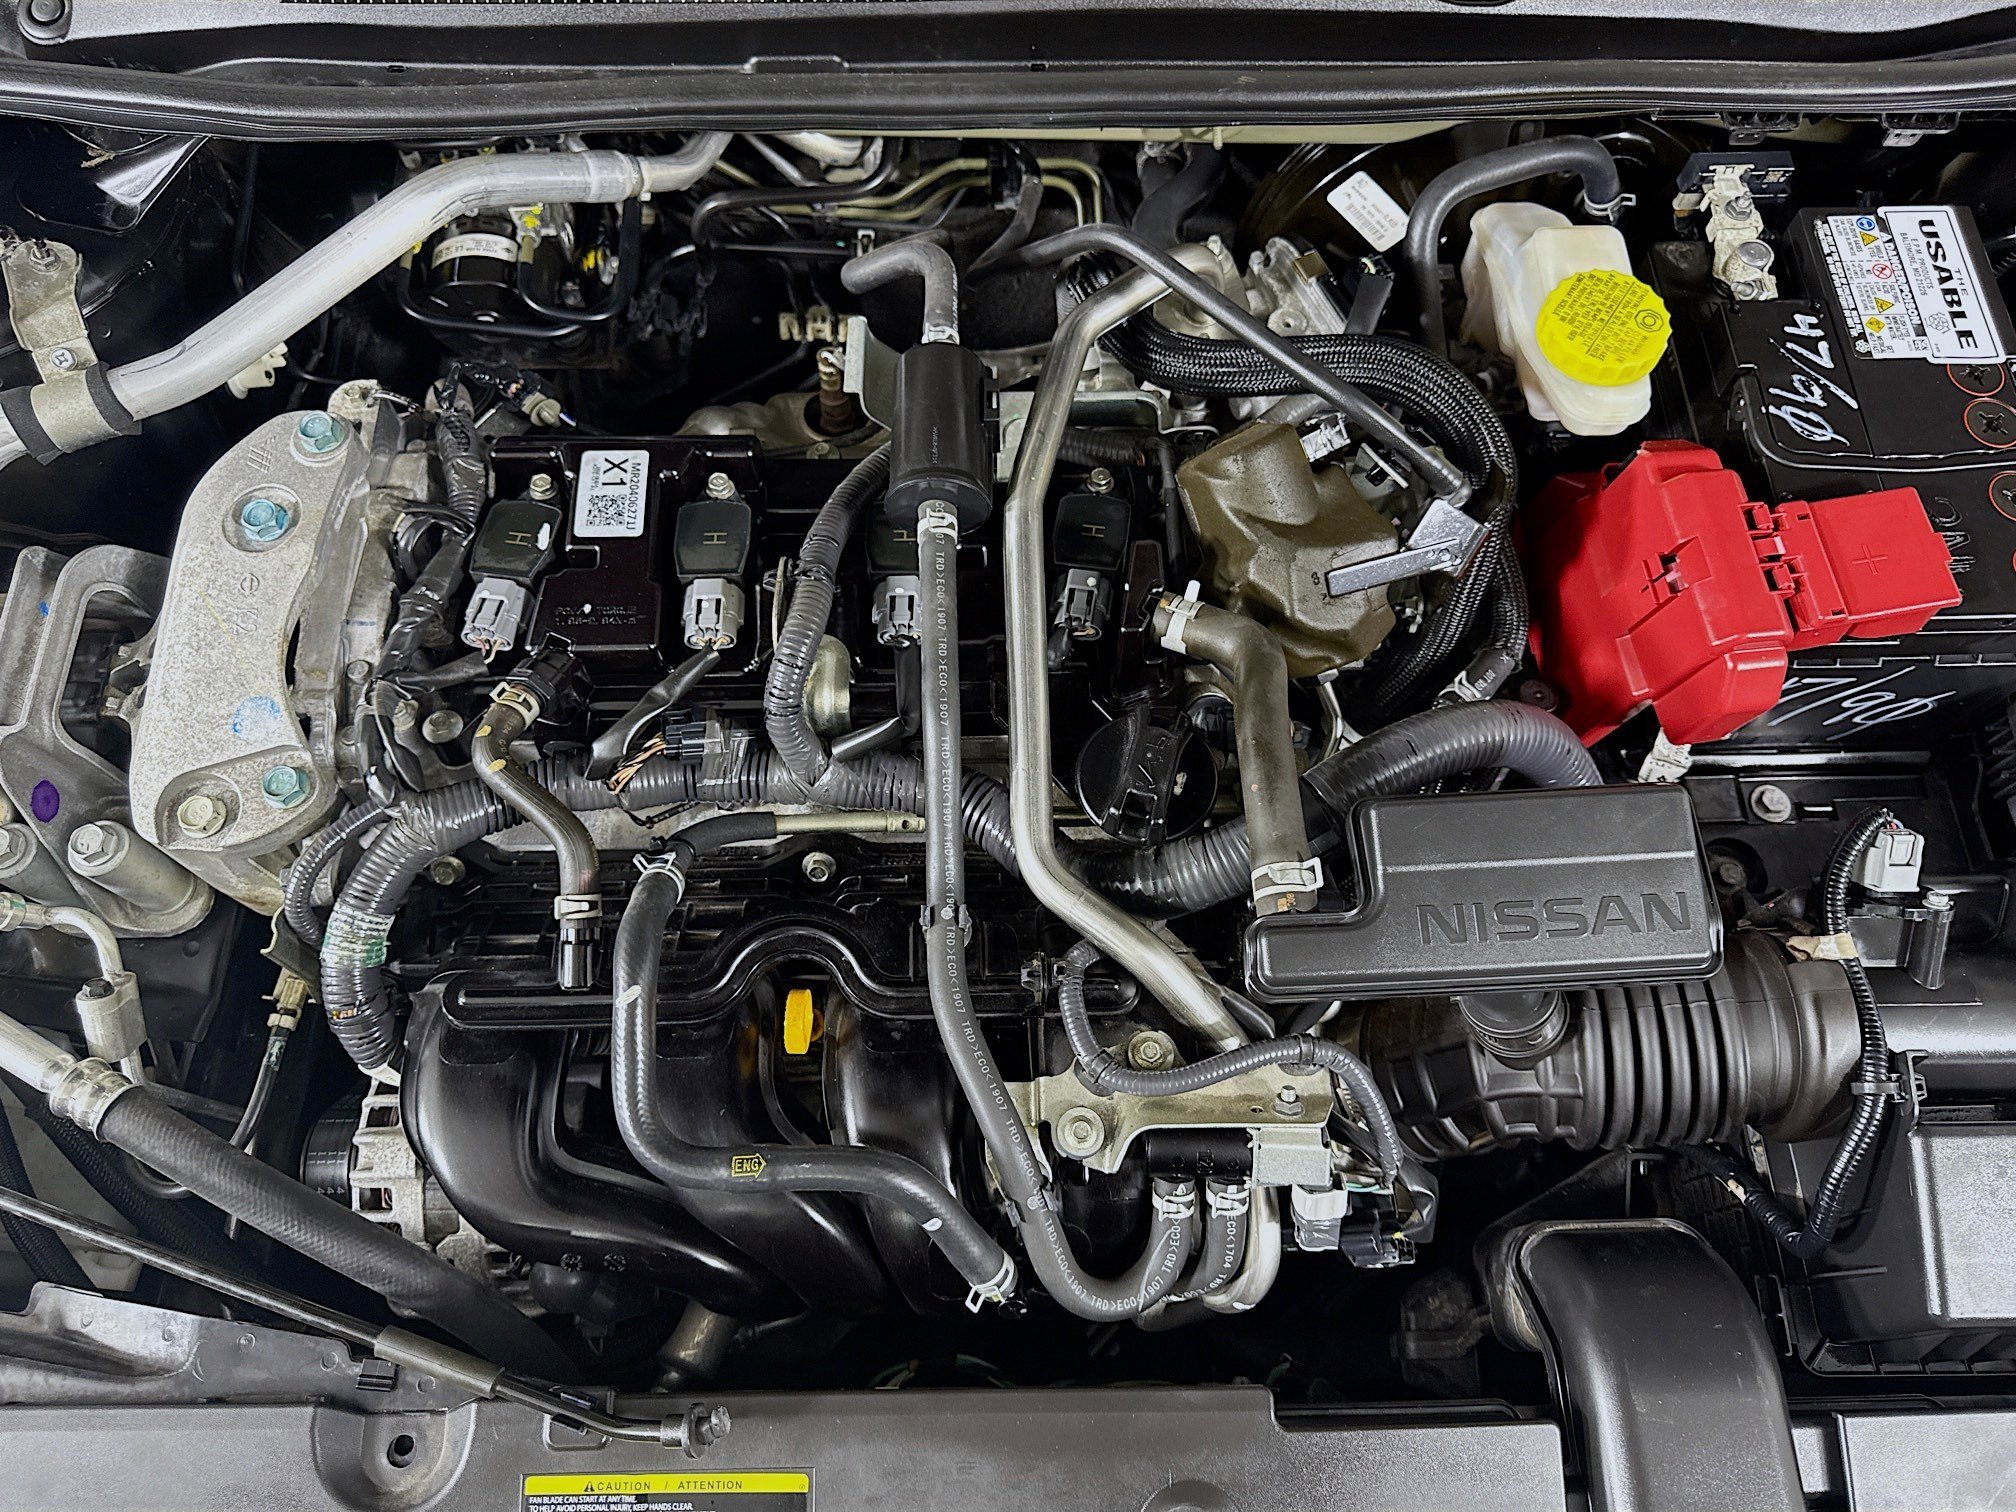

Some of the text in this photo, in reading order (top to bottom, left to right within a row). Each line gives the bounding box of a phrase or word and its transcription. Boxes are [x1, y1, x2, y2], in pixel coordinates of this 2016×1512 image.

[1899, 232, 1918, 266] BALTIMORE,
[1911, 267, 1921, 277] MD
[1563, 273, 1584, 300] CONTENANT
[1917, 258, 1934, 288] PRODUCTS
[1919, 220, 1978, 348] USABLE
[1953, 268, 1969, 295] THE
[942, 834, 956, 921] TRD>ECO<190
[1417, 890, 1691, 946] NISSAN
[736, 1158, 759, 1172] ENG
[597, 1482, 651, 1490] CAUTION
[678, 1480, 742, 1490] ATTENTION
[529, 1496, 542, 1504] FAN
[542, 1495, 563, 1504] BLADE
[564, 1495, 578, 1504] CAN
[579, 1495, 598, 1504] START
[600, 1495, 607, 1504] AT
[608, 1495, 620, 1504] ANY
[576, 1504, 609, 1512] PERSONAL
